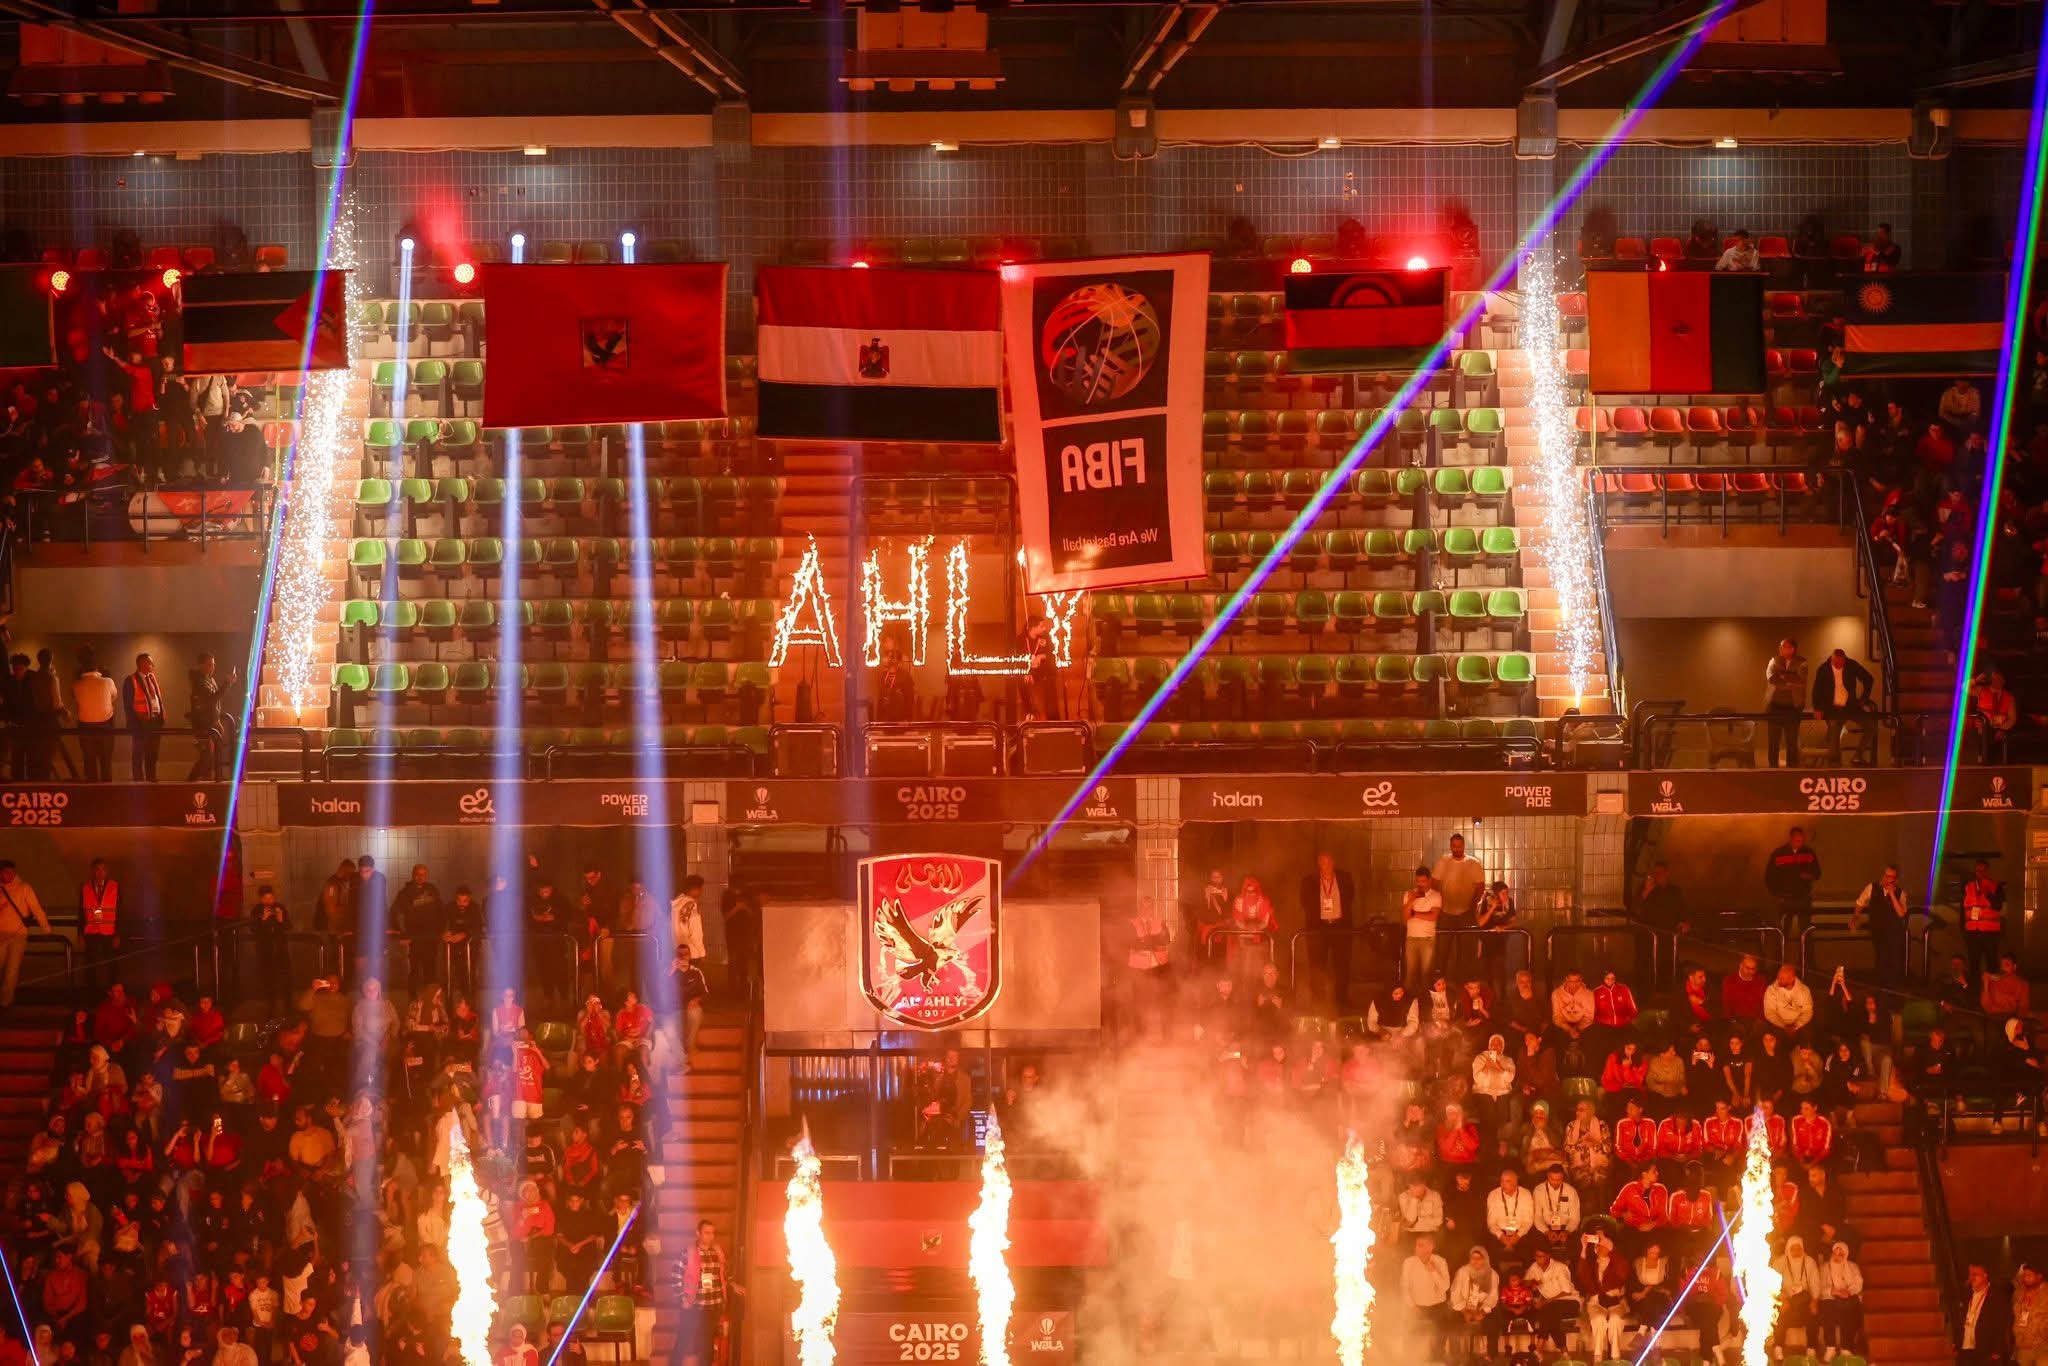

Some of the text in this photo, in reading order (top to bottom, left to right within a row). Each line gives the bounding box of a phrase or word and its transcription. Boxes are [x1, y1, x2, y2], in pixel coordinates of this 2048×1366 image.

[1505, 786, 1551, 798] POWER
[1799, 777, 1867, 794] CAIRO
[2, 791, 68, 808] CAIRO
[601, 794, 648, 805] POWER
[897, 786, 967, 803] CAIRO
[1212, 792, 1263, 807] halan
[1526, 797, 1551, 808] ADE
[311, 797, 361, 814] halan
[623, 805, 648, 816] ADE
[1807, 795, 1860, 811] 2025
[11, 809, 62, 825] 2025
[906, 804, 959, 820] 2025
[924, 995, 964, 1007] AHLY
[917, 1009, 946, 1017] 1907
[888, 1322, 969, 1342] CAIRO
[899, 1343, 961, 1361] 2025
